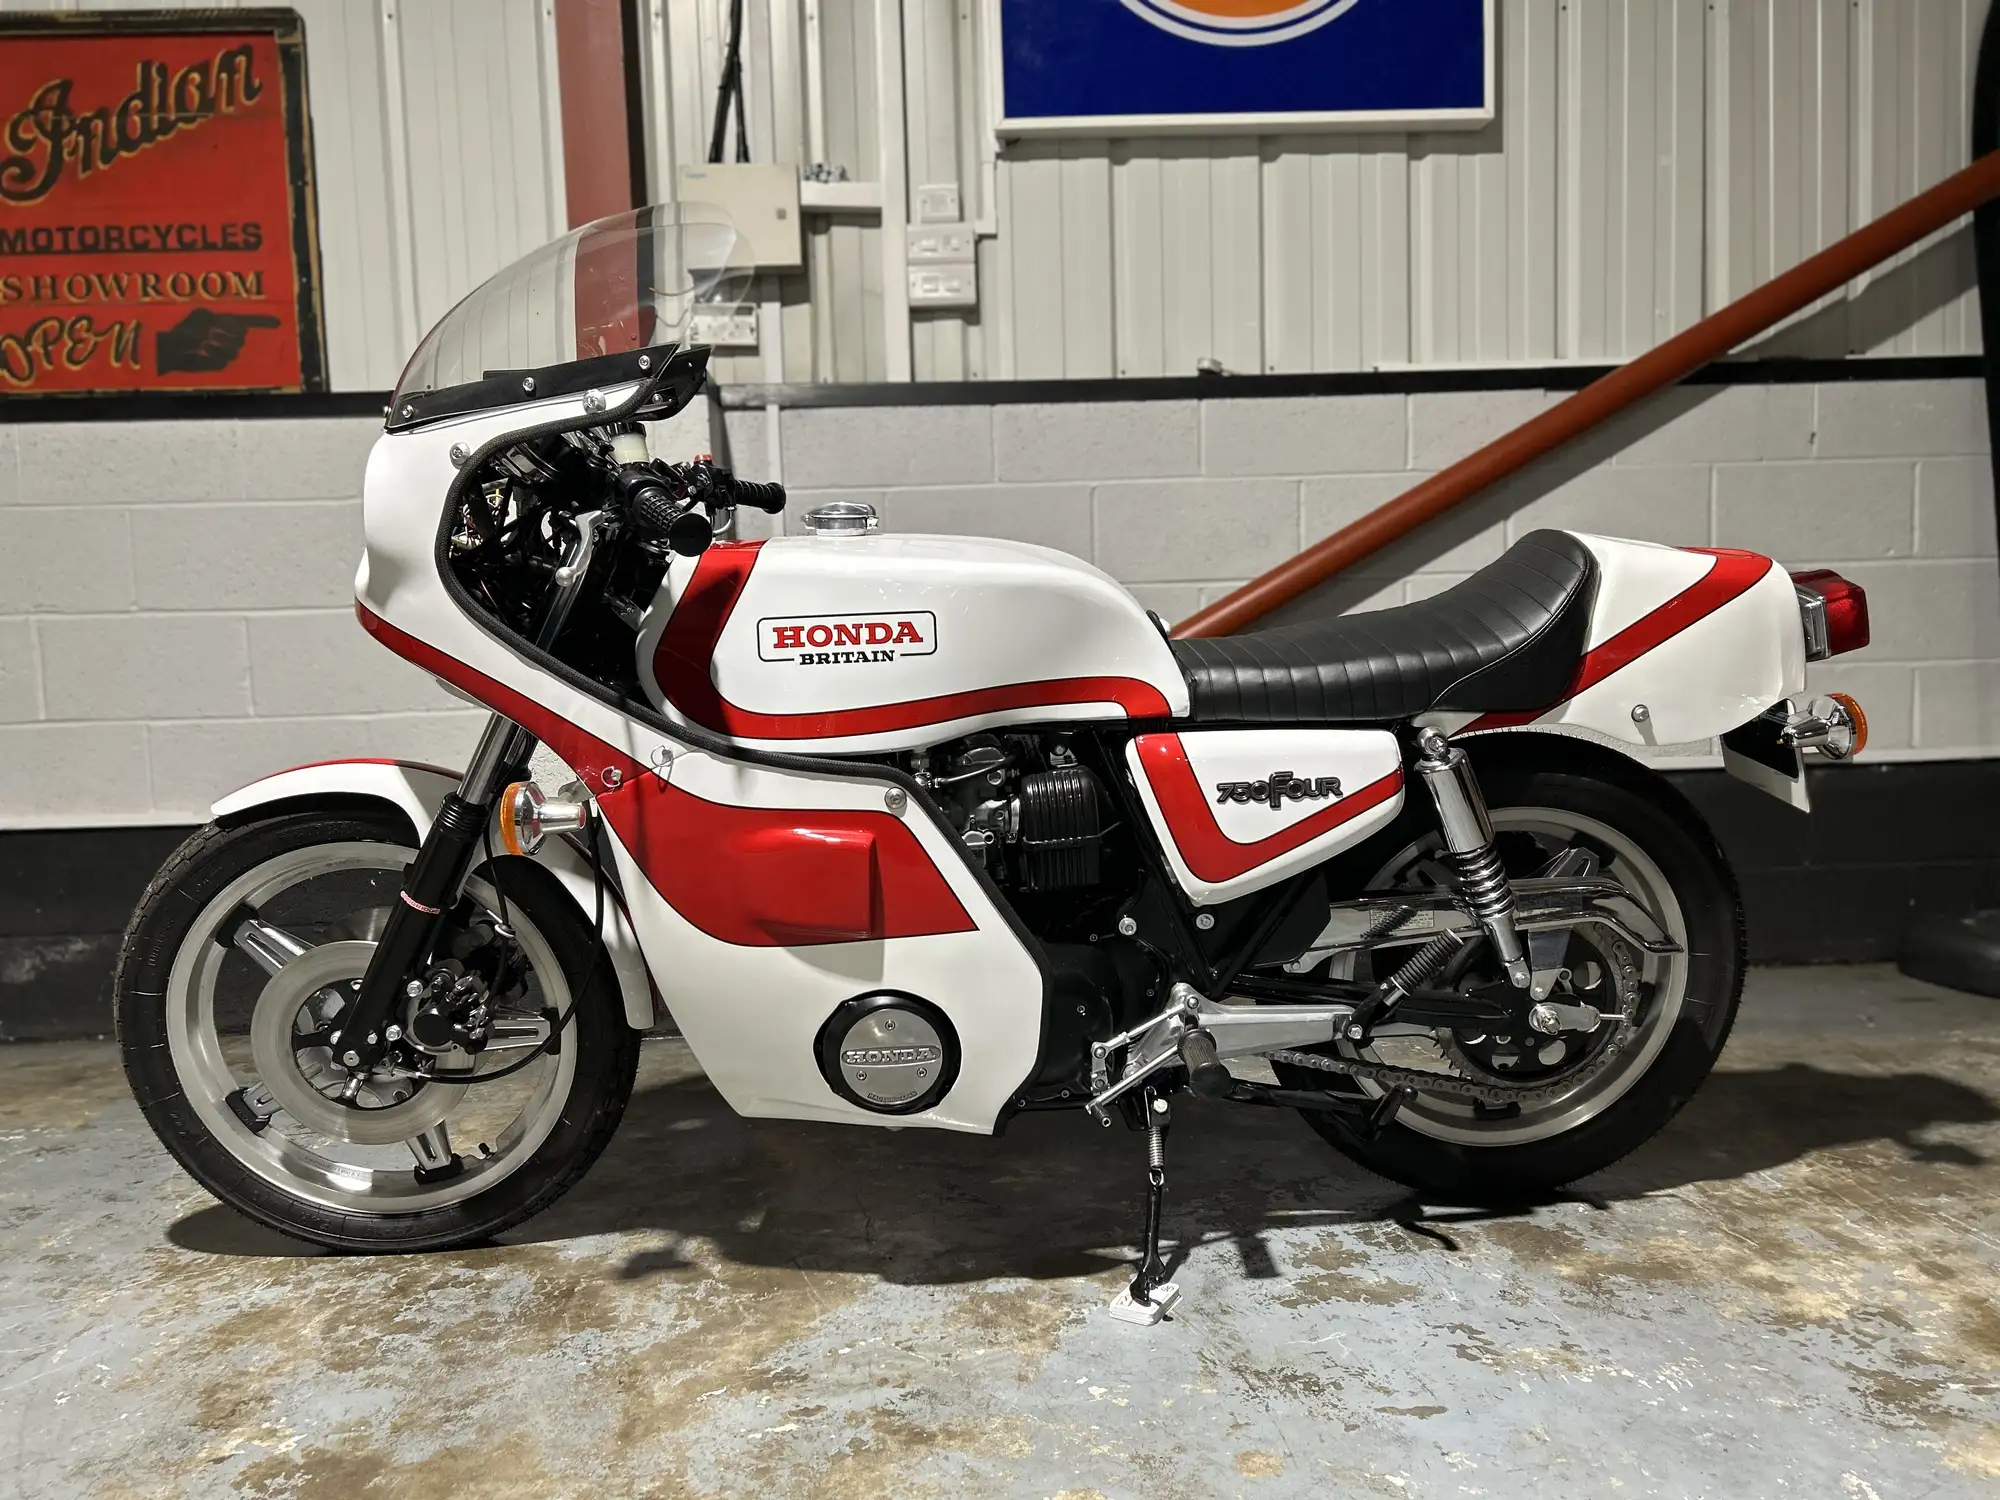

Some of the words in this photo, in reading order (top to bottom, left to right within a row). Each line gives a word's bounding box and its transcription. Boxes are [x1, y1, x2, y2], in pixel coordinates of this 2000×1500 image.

[0, 44, 263, 206] Indian
[0, 222, 263, 252] MOTORCYCLES
[0, 271, 266, 303] SHOWROOM
[773, 621, 924, 649] HONDA
[799, 650, 896, 666] BRITAIN
[846, 1047, 937, 1064] HONDA
